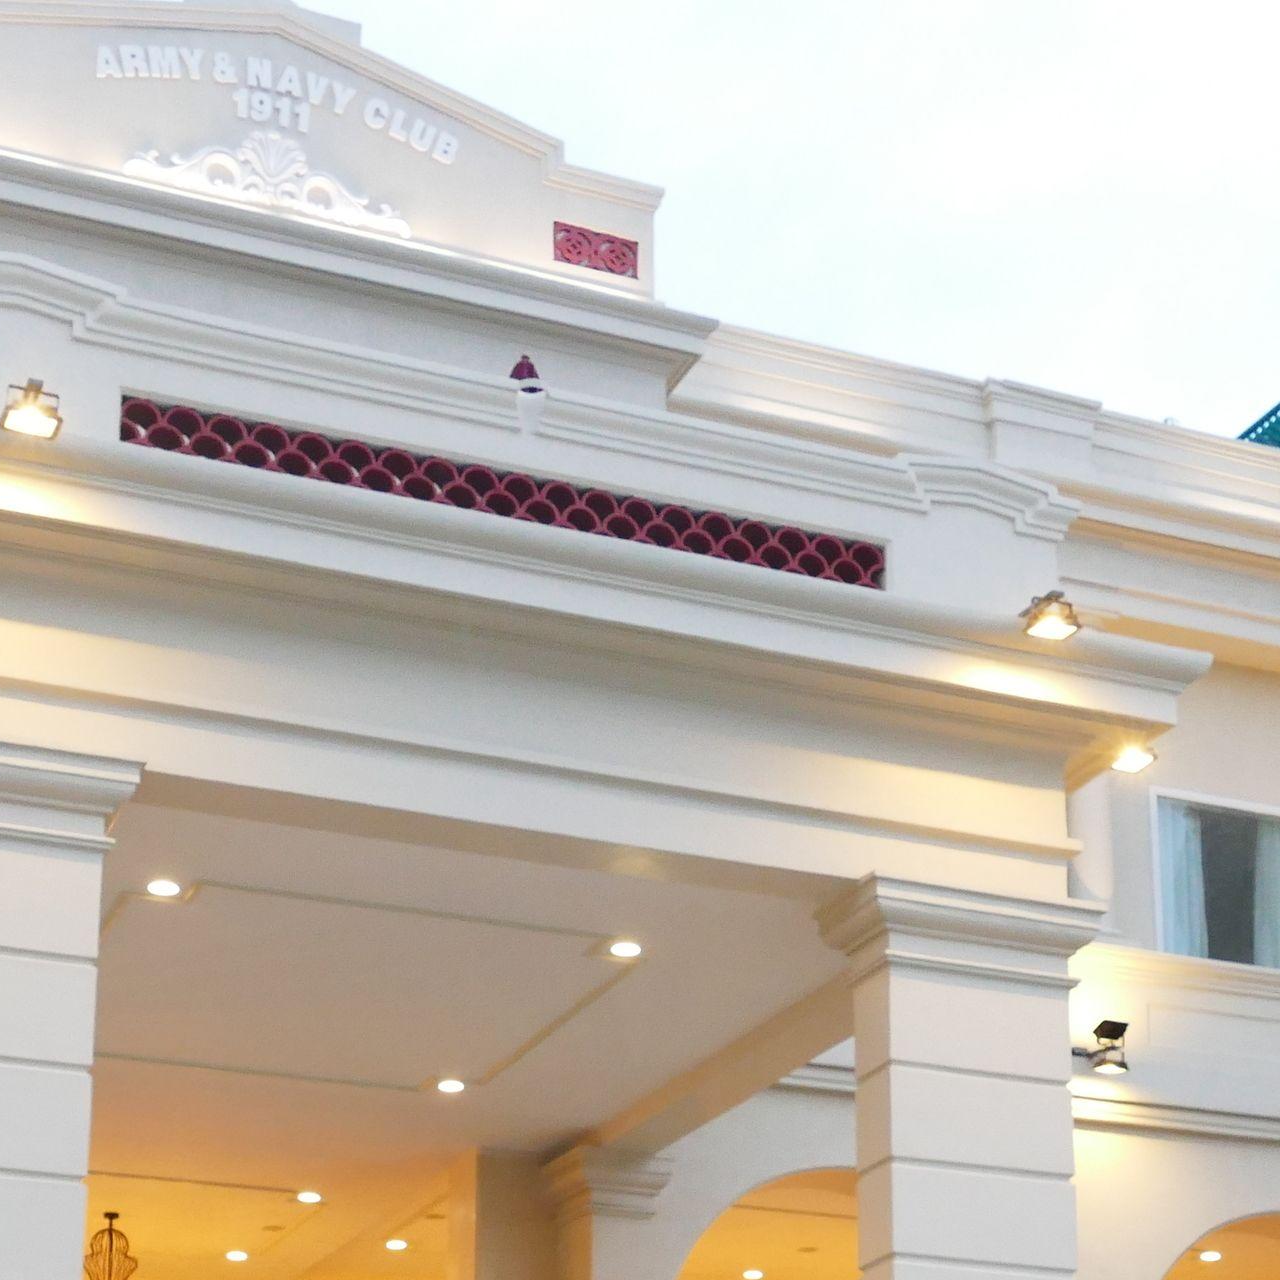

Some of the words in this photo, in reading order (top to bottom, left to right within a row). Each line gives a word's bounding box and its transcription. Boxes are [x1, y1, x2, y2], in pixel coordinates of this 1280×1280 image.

[96, 44, 206, 80] ARMY
[212, 51, 238, 84] &
[246, 57, 357, 114] NAVY
[363, 99, 460, 165] CLUB
[232, 88, 311, 132] 1911
